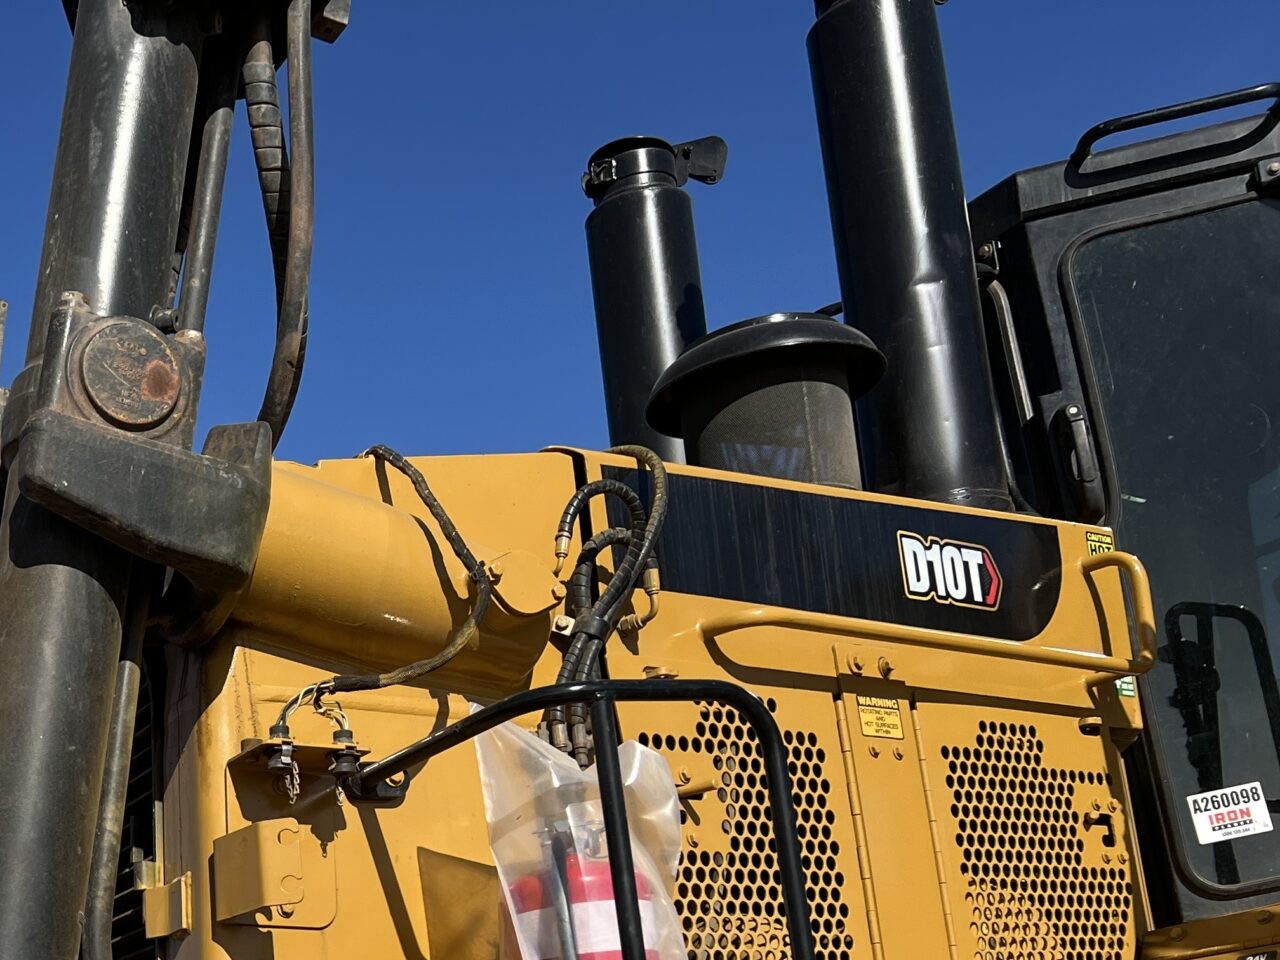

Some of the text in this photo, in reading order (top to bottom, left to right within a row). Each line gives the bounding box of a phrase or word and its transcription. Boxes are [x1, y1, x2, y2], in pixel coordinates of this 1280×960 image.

[901, 537, 984, 603] D10T
[857, 695, 899, 708] WARNING
[1192, 786, 1261, 814] A260098
[1208, 807, 1252, 826] IRON
